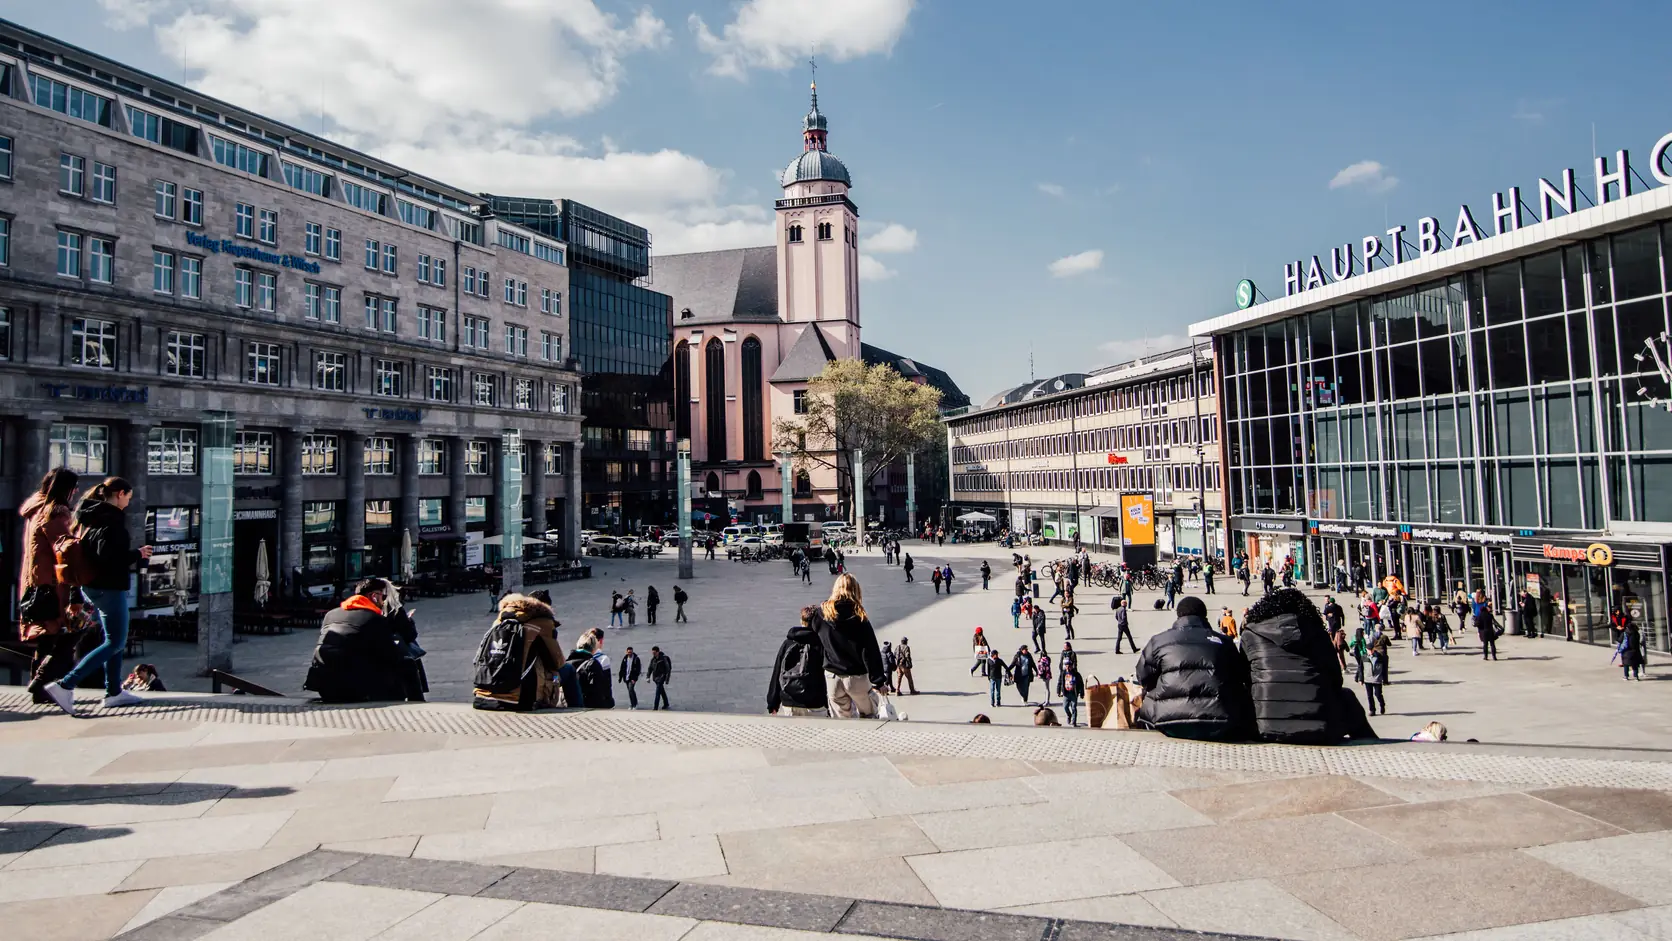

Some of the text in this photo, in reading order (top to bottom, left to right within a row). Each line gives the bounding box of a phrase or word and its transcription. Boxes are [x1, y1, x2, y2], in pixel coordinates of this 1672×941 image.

[186, 230, 219, 253] Verlag
[281, 254, 290, 267] &
[1239, 283, 1248, 306] S
[1318, 523, 1352, 535] NetCologne
[1364, 525, 1397, 537] Highspeed
[1412, 528, 1454, 540] NetCologne
[1543, 544, 1586, 562] Kamps
